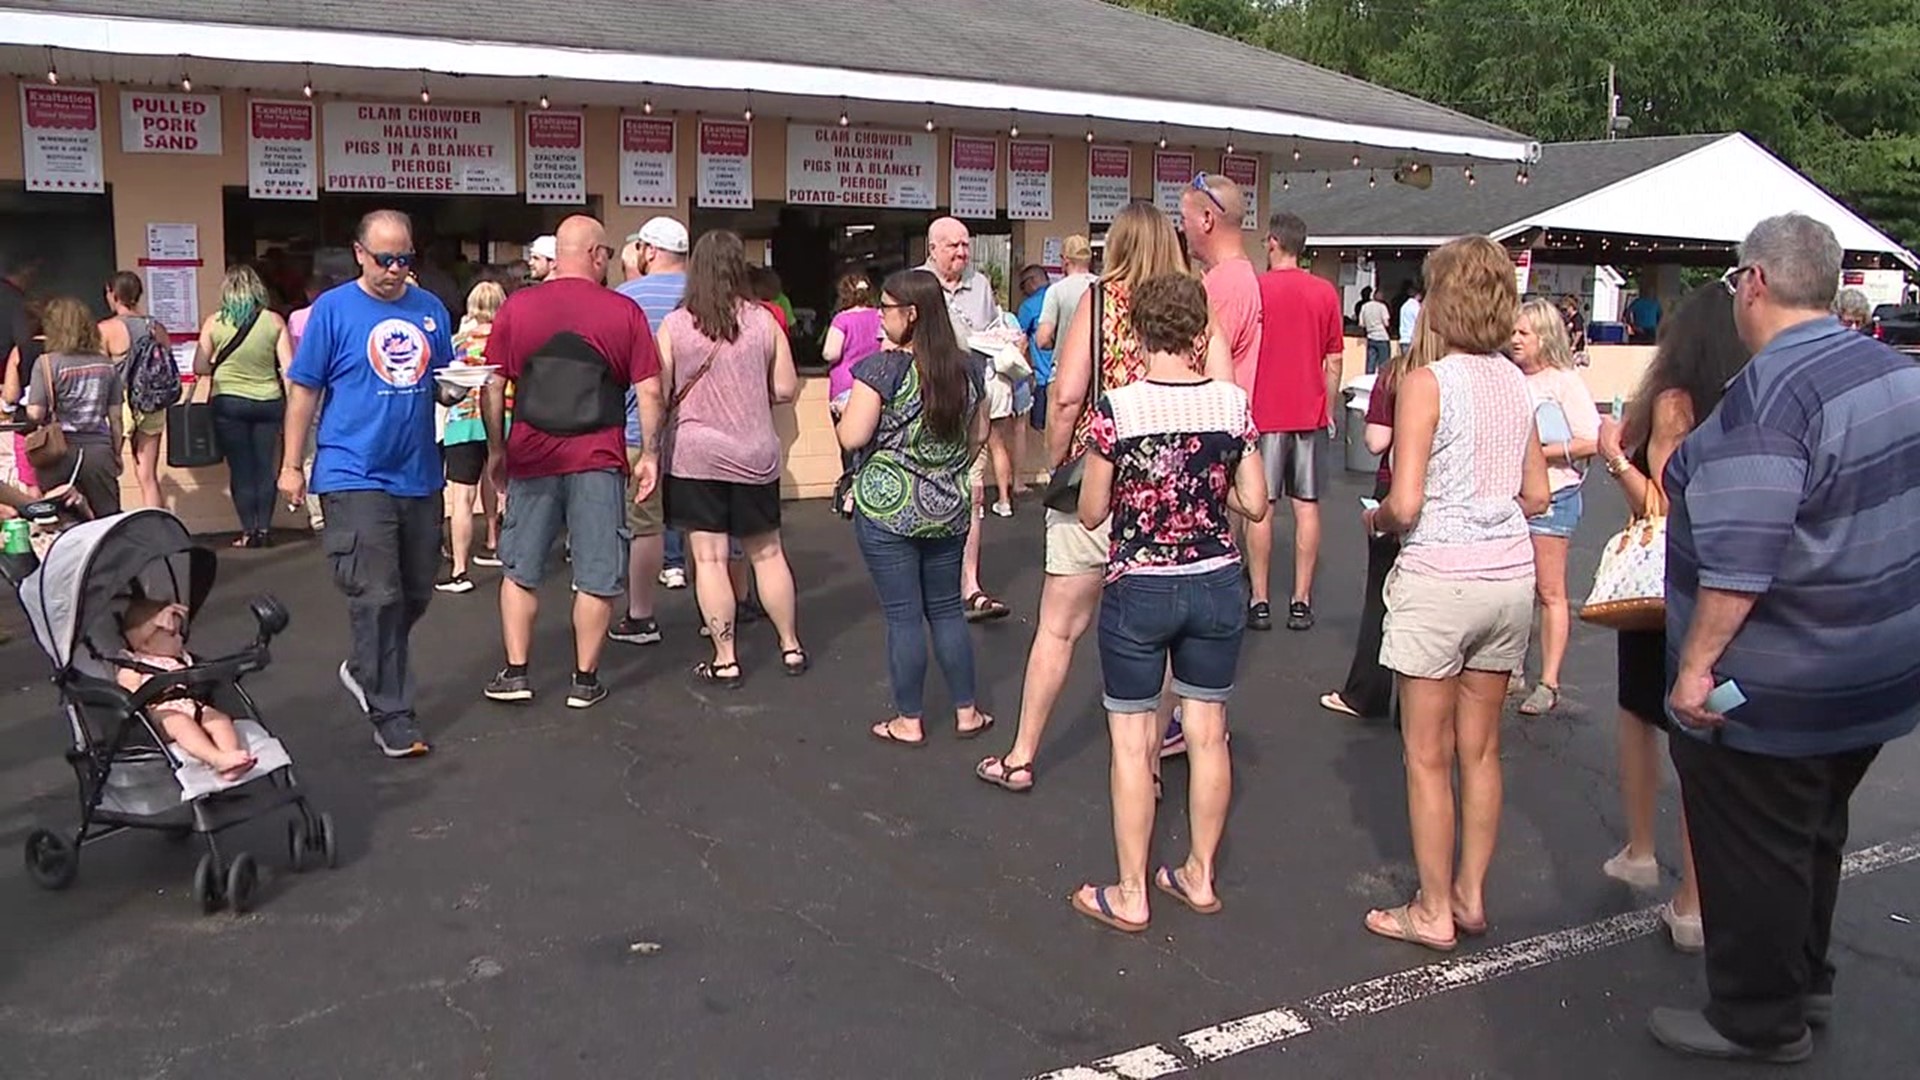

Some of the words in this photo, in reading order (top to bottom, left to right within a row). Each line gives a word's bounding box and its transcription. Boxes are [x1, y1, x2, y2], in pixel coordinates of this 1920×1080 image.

[29, 90, 92, 103] Exaltation
[132, 98, 206, 115] PULLED
[358, 106, 401, 121] CLAM
[408, 108, 481, 124] CHOWDER
[143, 117, 196, 132] PORK
[383, 125, 458, 140] HALUSHKI
[144, 134, 198, 150] SAND
[815, 129, 849, 143] CLAM
[855, 132, 912, 147] CHOWDER
[345, 141, 380, 155] PIGS
[387, 143, 403, 156] IN
[411, 143, 421, 156] A
[428, 144, 494, 158] BLANKET
[834, 146, 894, 160] HALUSHKI
[392, 159, 451, 173] PIEROGI
[535, 154, 576, 162] EXALTATION
[803, 159, 831, 172] PIGS
[837, 161, 850, 174] IN
[856, 162, 864, 174] A
[869, 163, 922, 177] BLANKET
[329, 175, 460, 191] POTATO-CHEESE-
[840, 176, 888, 190] PIEROGI
[789, 189, 896, 205] POTATO-CHEESE-
